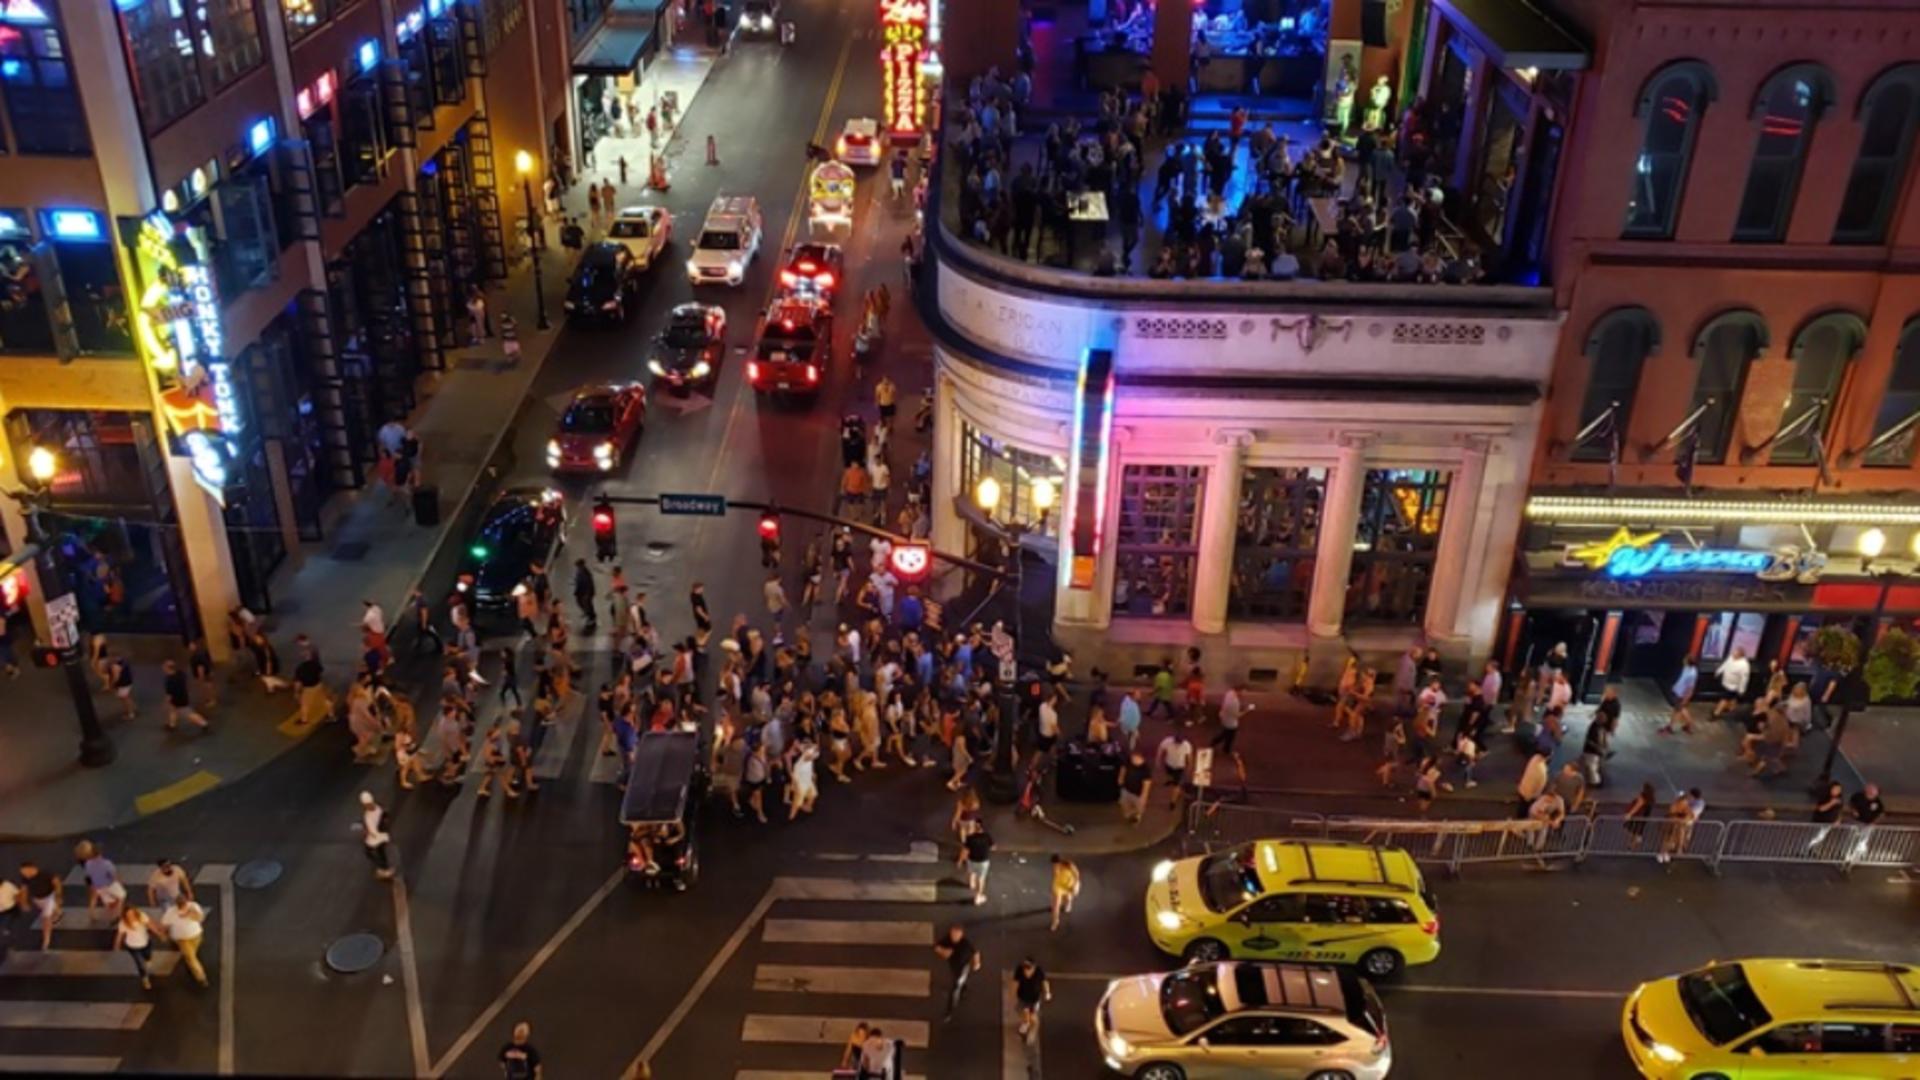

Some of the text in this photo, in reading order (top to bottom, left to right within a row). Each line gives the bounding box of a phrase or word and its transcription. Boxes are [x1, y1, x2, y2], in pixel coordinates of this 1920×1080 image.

[896, 43, 915, 131] PIZZA
[976, 301, 1063, 334] AERICAN
[190, 266, 243, 434] HONKY TONK
[662, 497, 720, 513] Broadway
[1608, 543, 1766, 578] Wanna
